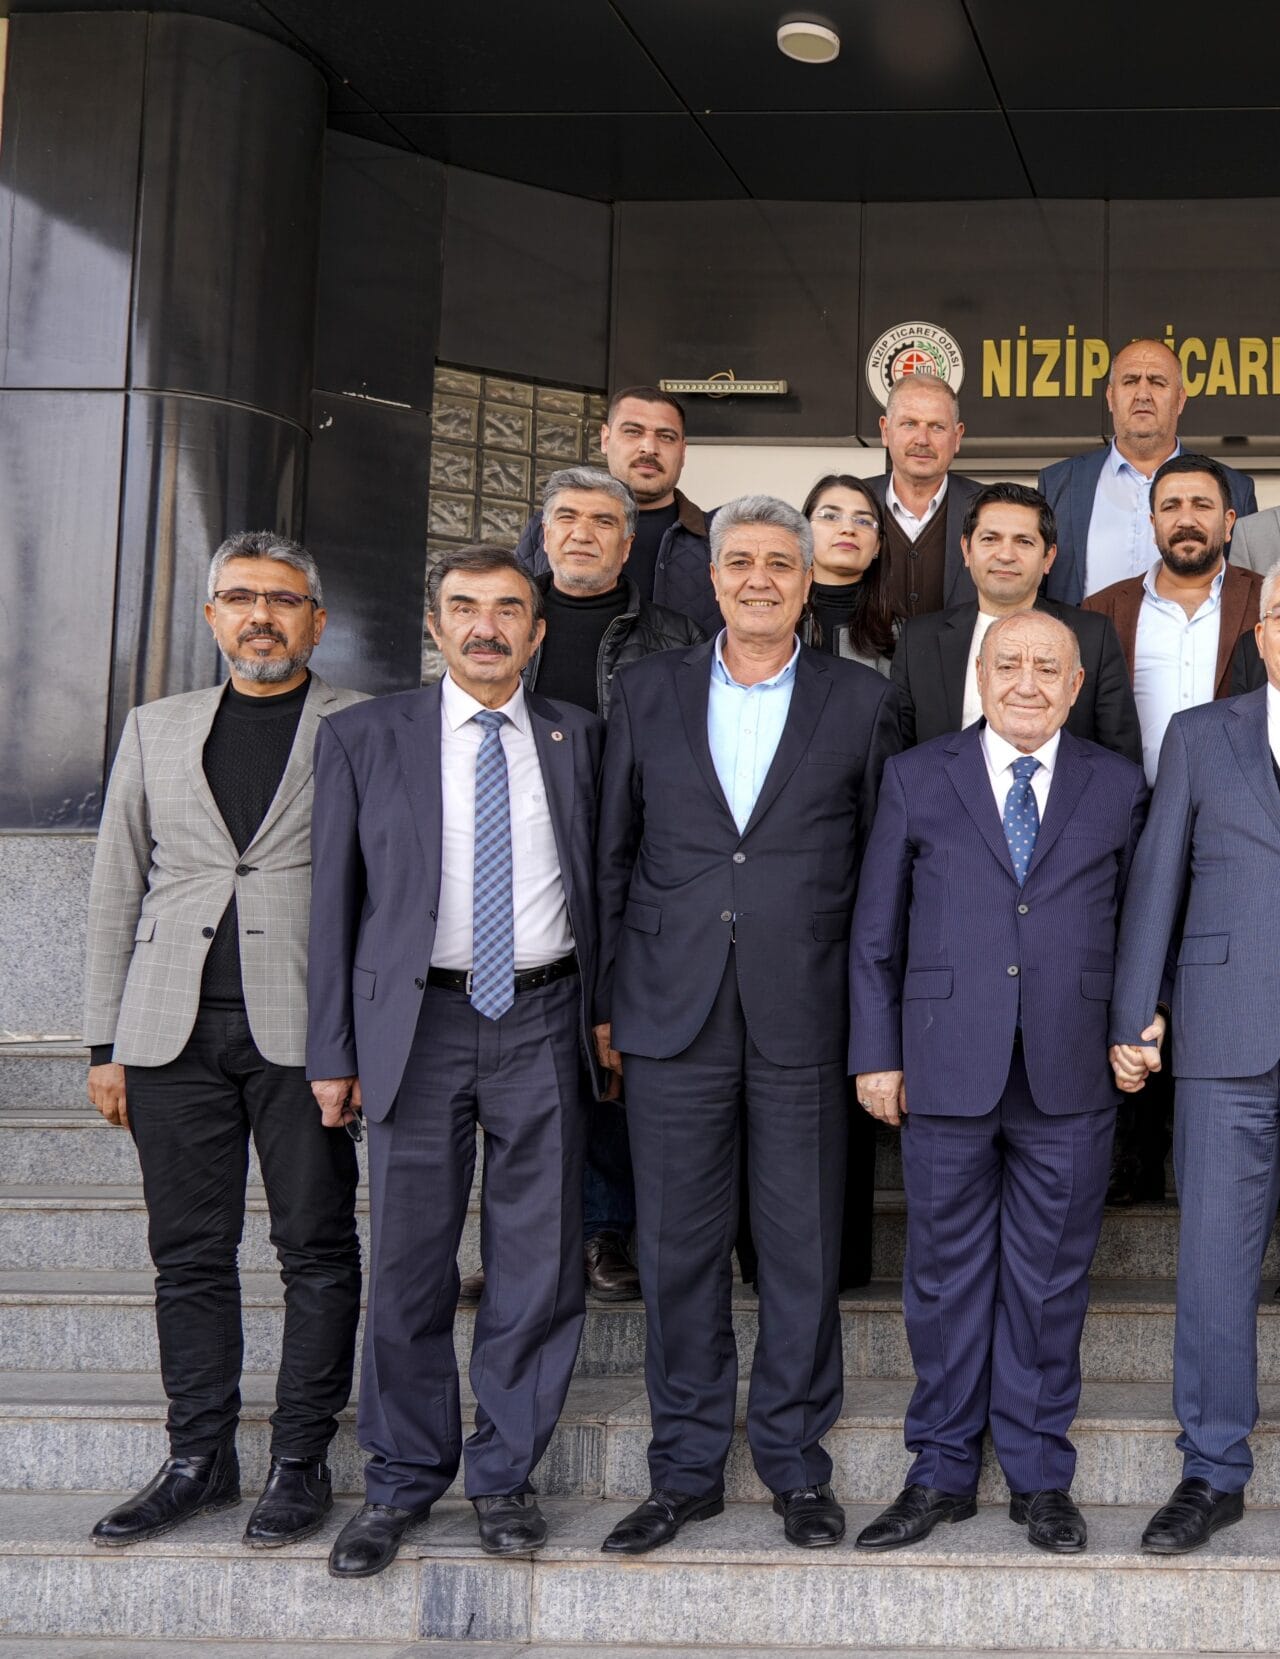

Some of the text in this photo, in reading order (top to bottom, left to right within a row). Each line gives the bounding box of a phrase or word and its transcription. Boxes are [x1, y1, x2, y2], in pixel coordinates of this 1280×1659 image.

[872, 327, 960, 368] NİZİP TİCARET ODASI
[982, 325, 1110, 397] NİZİP
[915, 365, 932, 375] NTO
